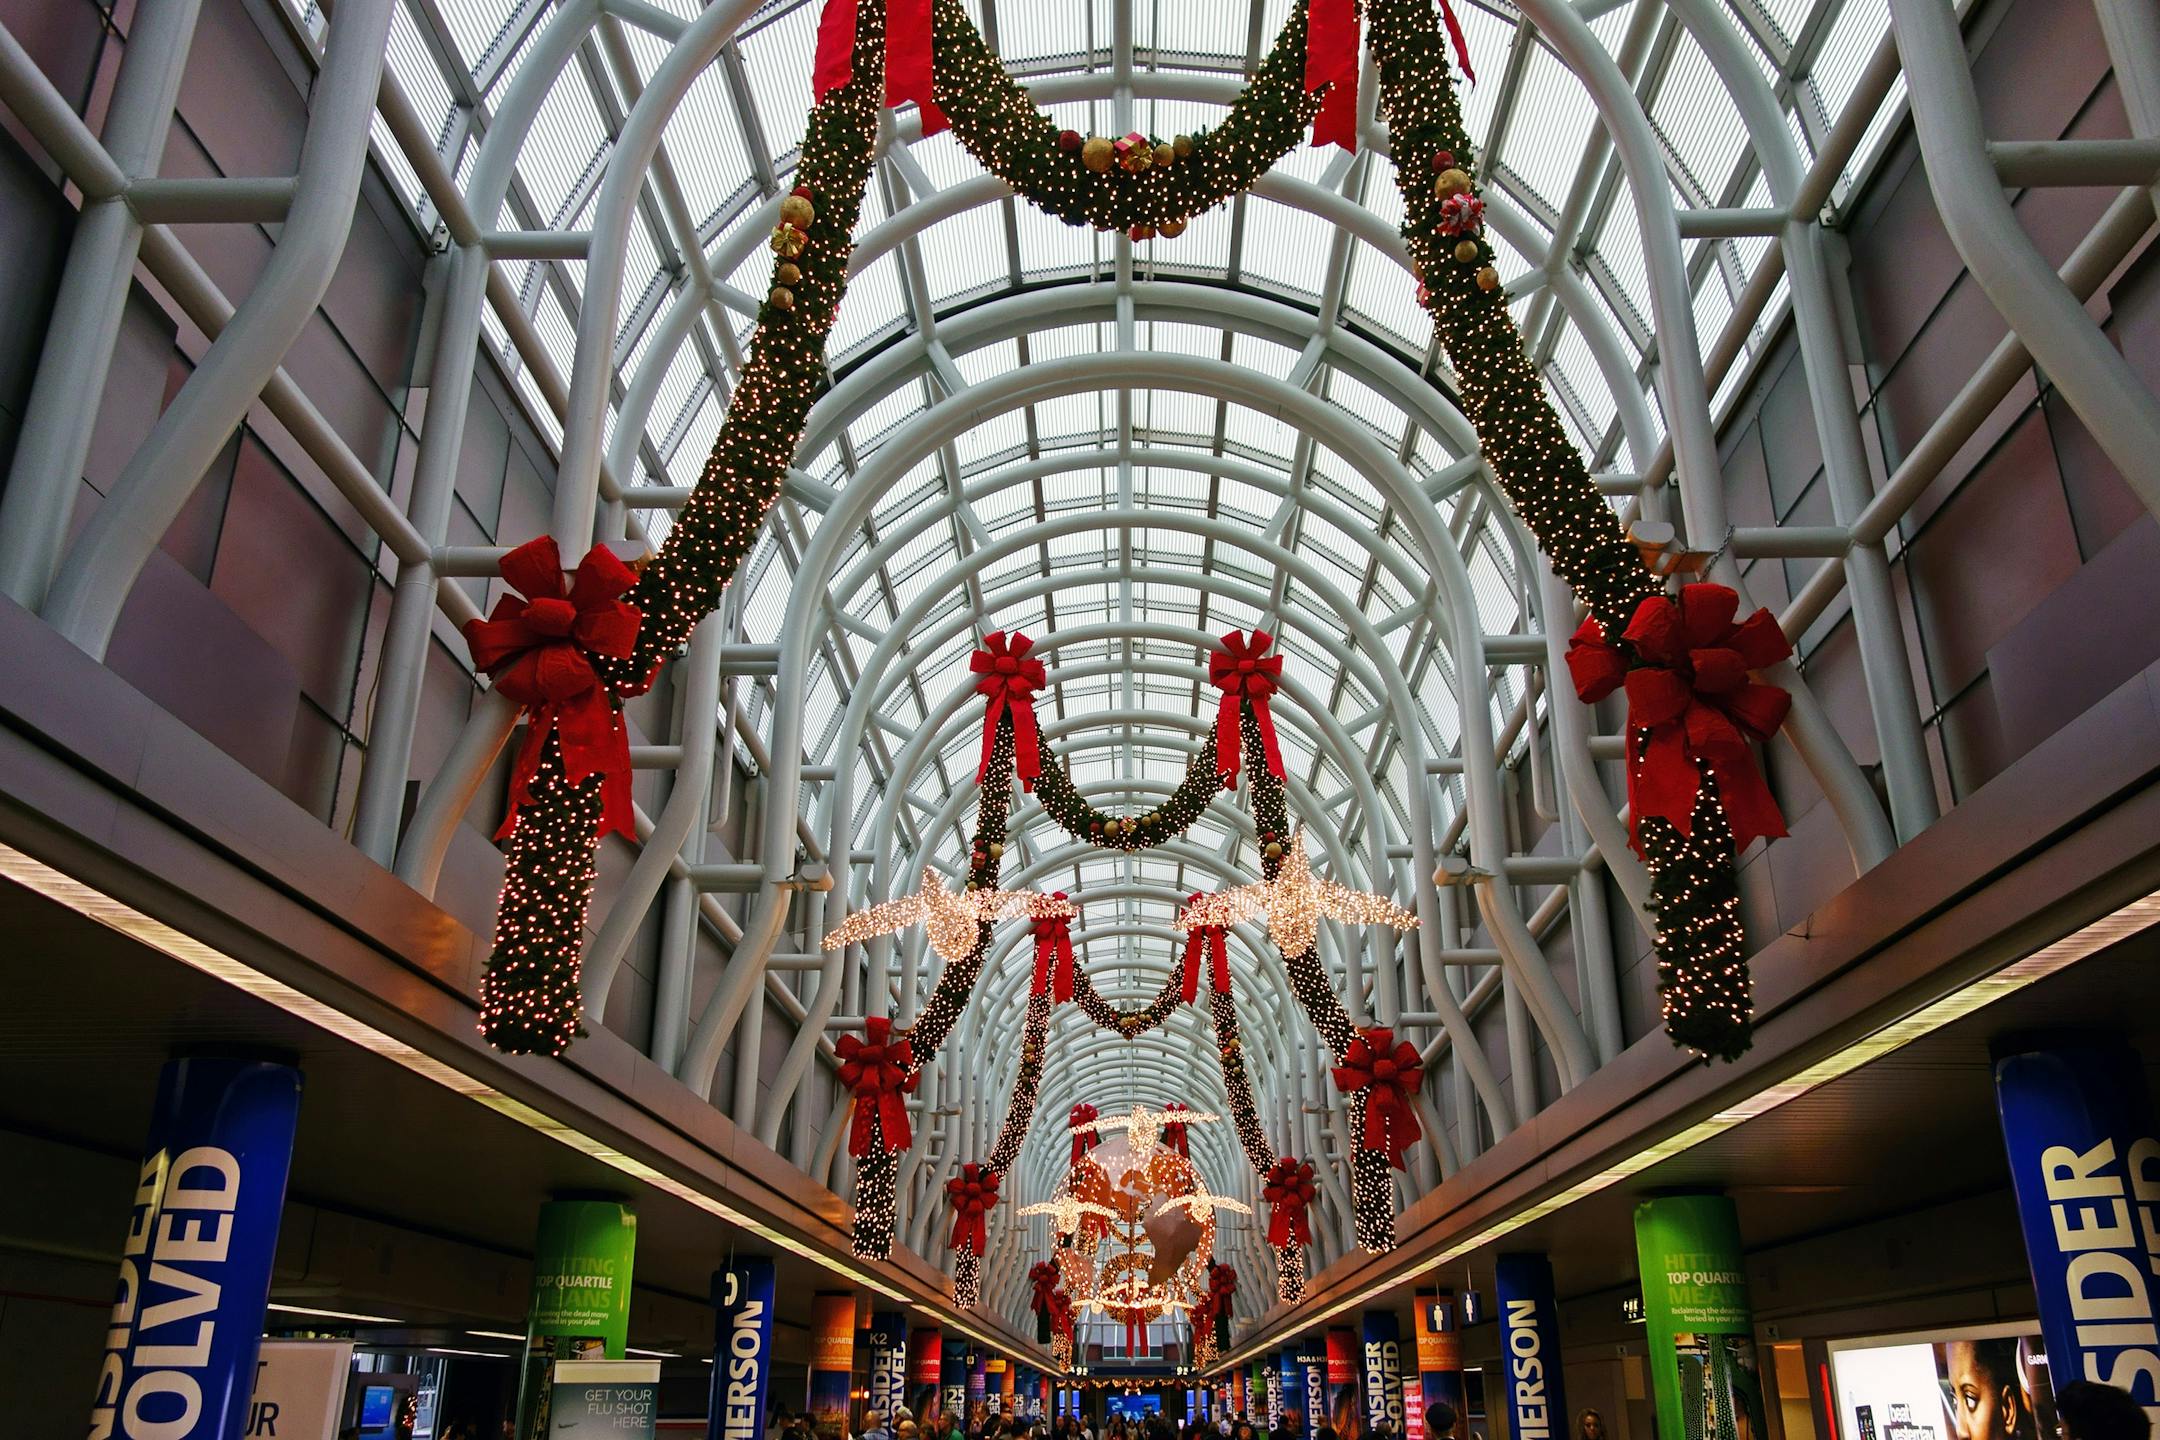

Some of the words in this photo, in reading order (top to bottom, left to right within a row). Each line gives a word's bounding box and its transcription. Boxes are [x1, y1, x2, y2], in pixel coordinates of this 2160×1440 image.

[555, 1275, 613, 1289] QUARTILE
[1666, 1271, 1690, 1285] TOP
[2041, 1137, 2160, 1440] SIDER
[870, 1333, 888, 1345] K2
[1365, 1341, 1386, 1431] NSIDER
[585, 1389, 610, 1402] GET
[616, 1389, 652, 1402] YOUR
[942, 1388, 965, 1404] 125
[588, 1402, 615, 1415] FLU
[616, 1402, 652, 1415] SHOT
[613, 1416, 650, 1428] HERE.
